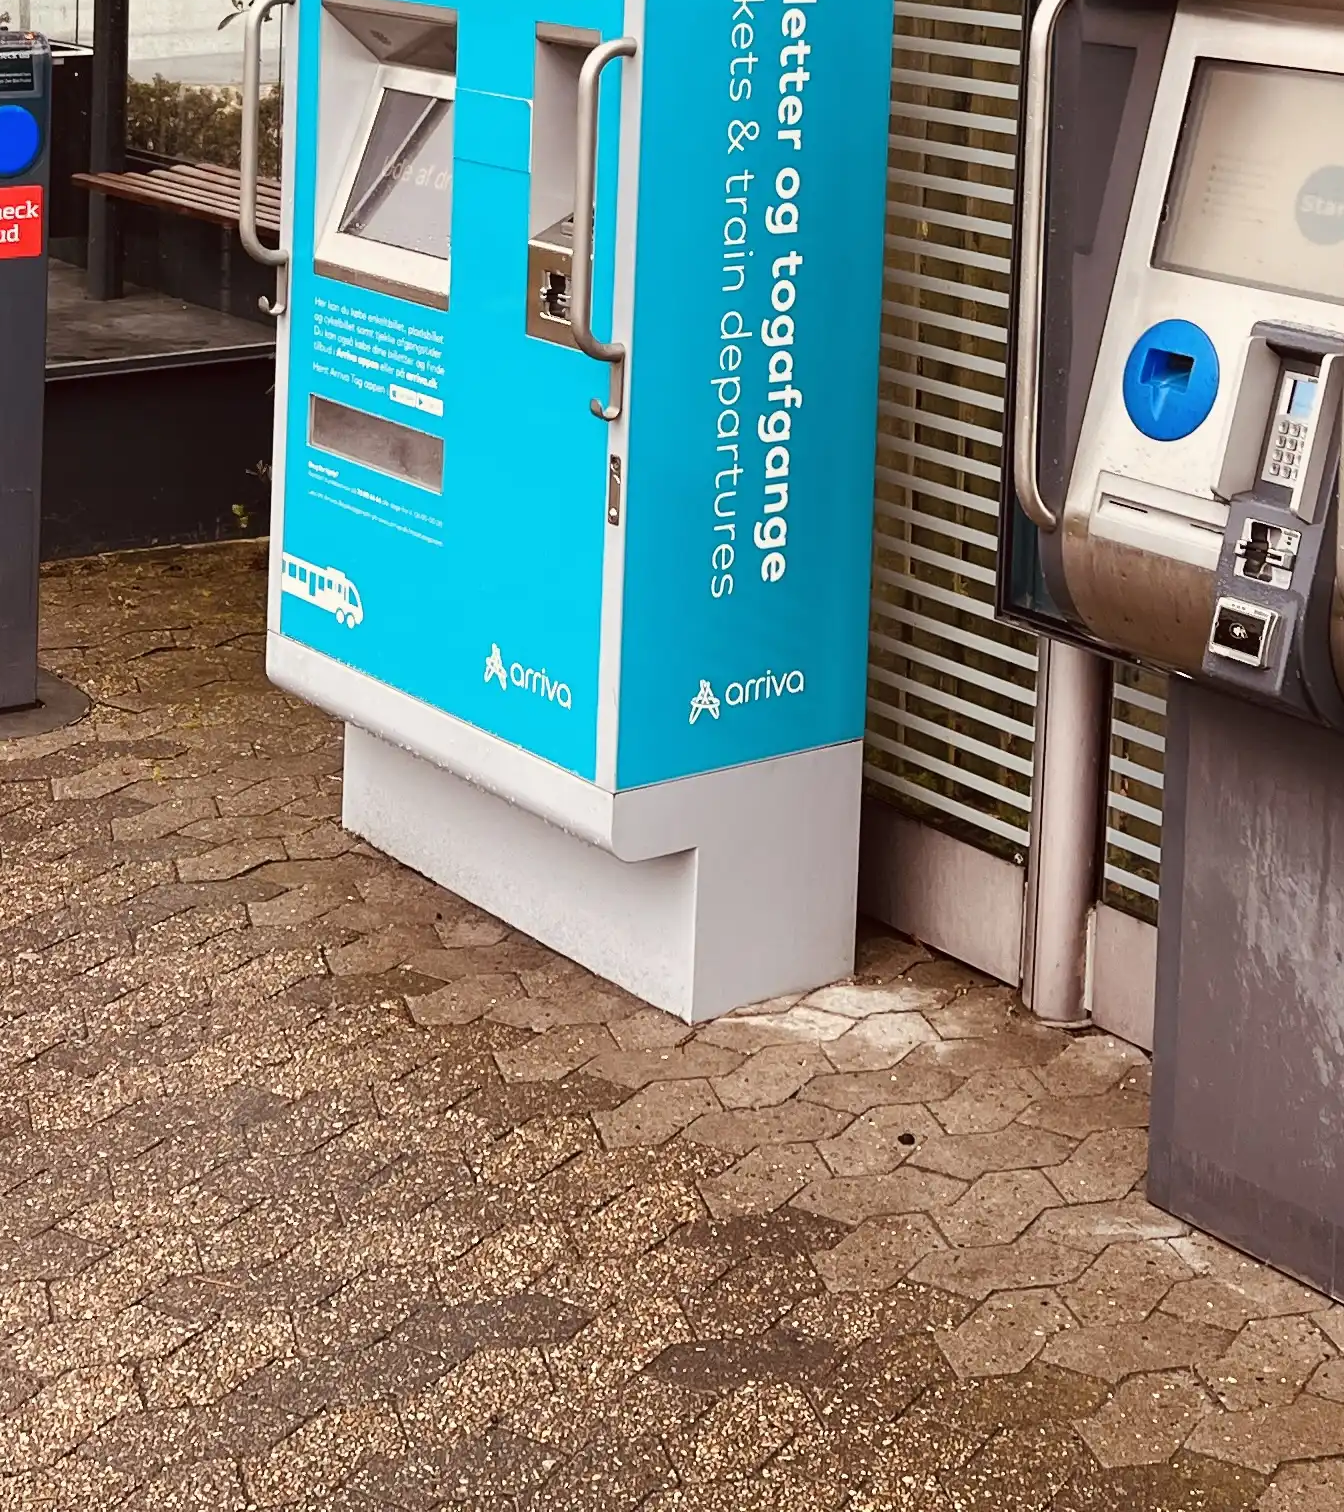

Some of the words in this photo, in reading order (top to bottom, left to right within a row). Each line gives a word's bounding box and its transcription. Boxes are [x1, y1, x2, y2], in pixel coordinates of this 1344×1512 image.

[727, 119, 760, 154] &
[765, 167, 800, 235] og
[722, 169, 755, 291] train
[313, 313, 323, 324] og
[314, 297, 327, 308] Her
[327, 300, 339, 312] kan
[340, 304, 349, 315] du
[313, 324, 323, 336] Du
[324, 329, 336, 340] kan
[415, 359, 425, 371] og
[336, 347, 357, 363] Arriva
[351, 373, 363, 389] Tog
[753, 250, 804, 583] togafgange
[710, 310, 753, 598] departures
[510, 663, 573, 710] arriva
[725, 668, 805, 707] arriva
